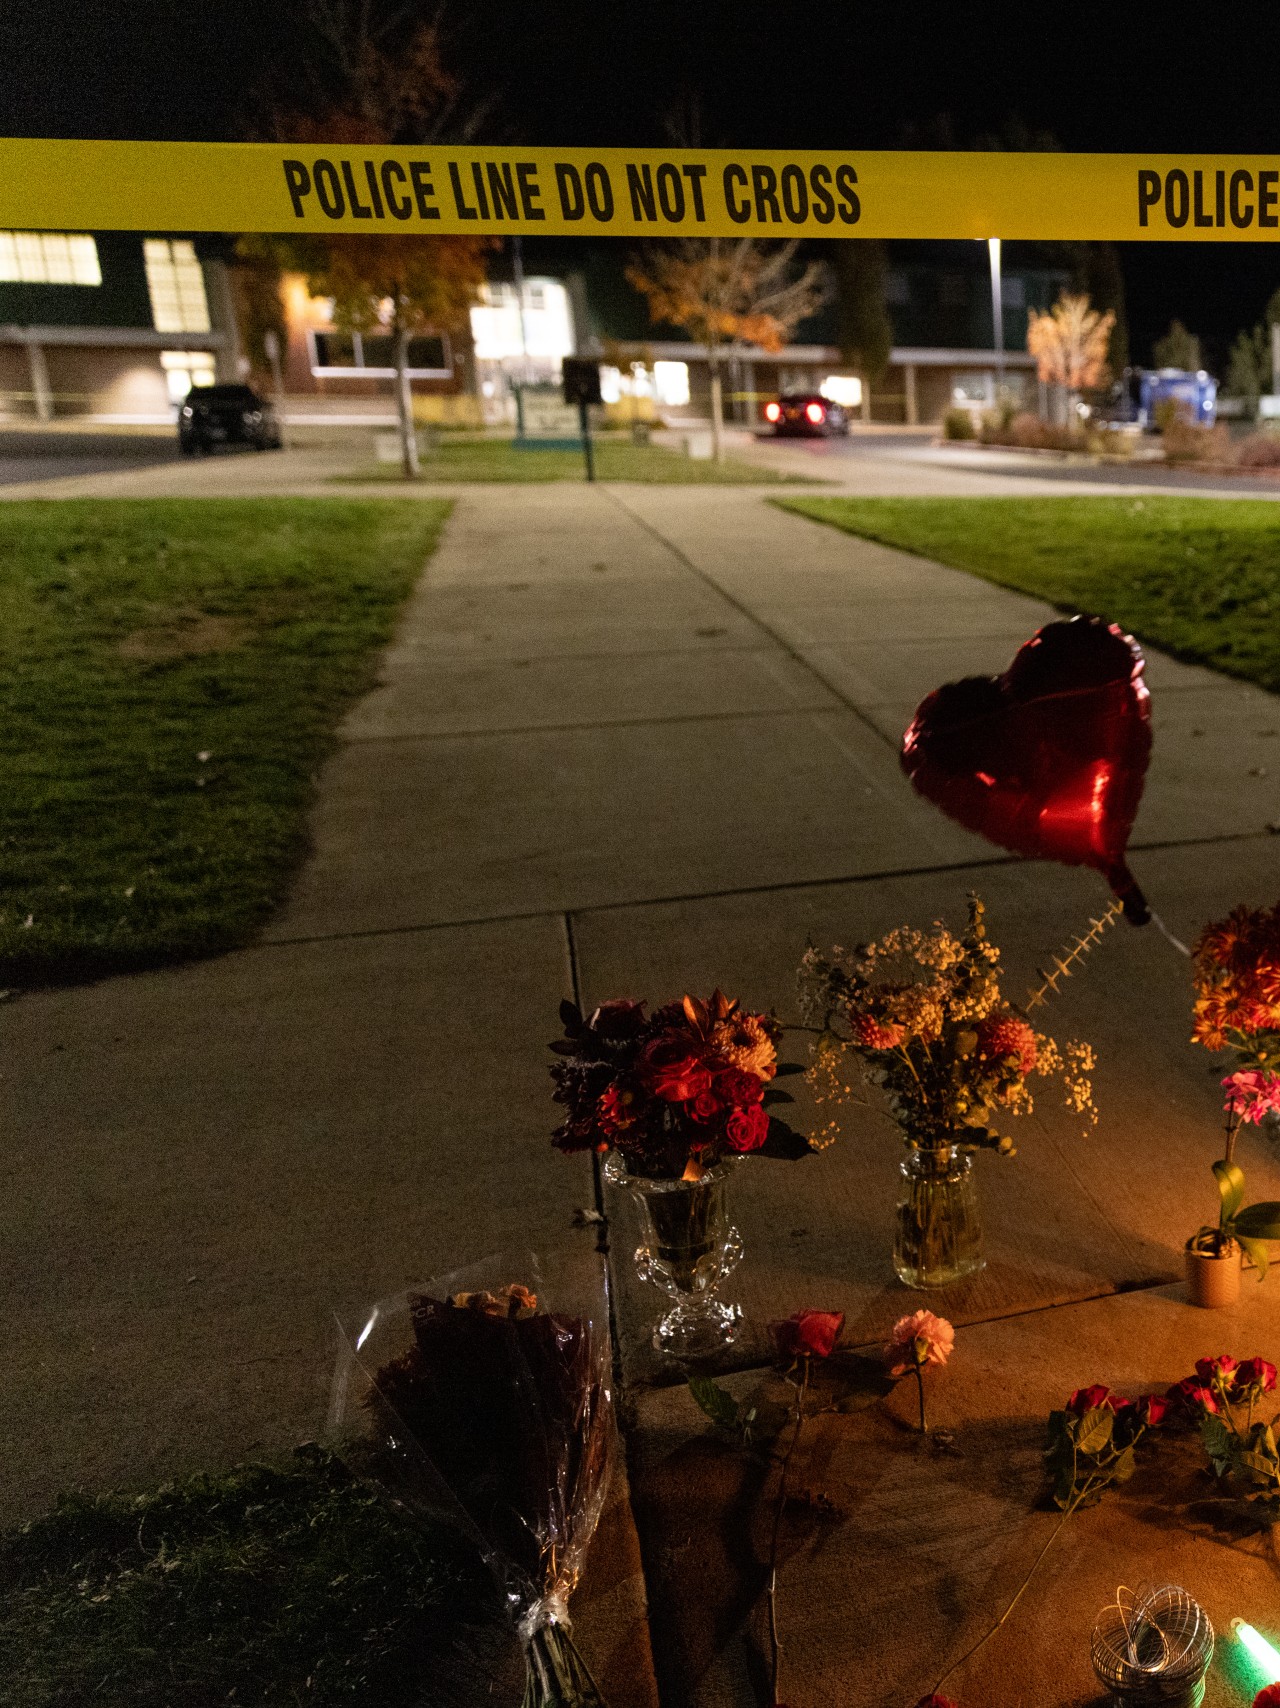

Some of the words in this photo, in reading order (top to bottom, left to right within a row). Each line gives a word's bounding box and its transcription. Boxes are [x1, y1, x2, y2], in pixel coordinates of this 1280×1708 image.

[282, 159, 440, 220] POLICE
[448, 162, 545, 221] LINE
[554, 163, 614, 222] DO
[626, 164, 707, 223] NOT
[723, 163, 860, 225] CROSS
[1138, 169, 1279, 229] POLICE
